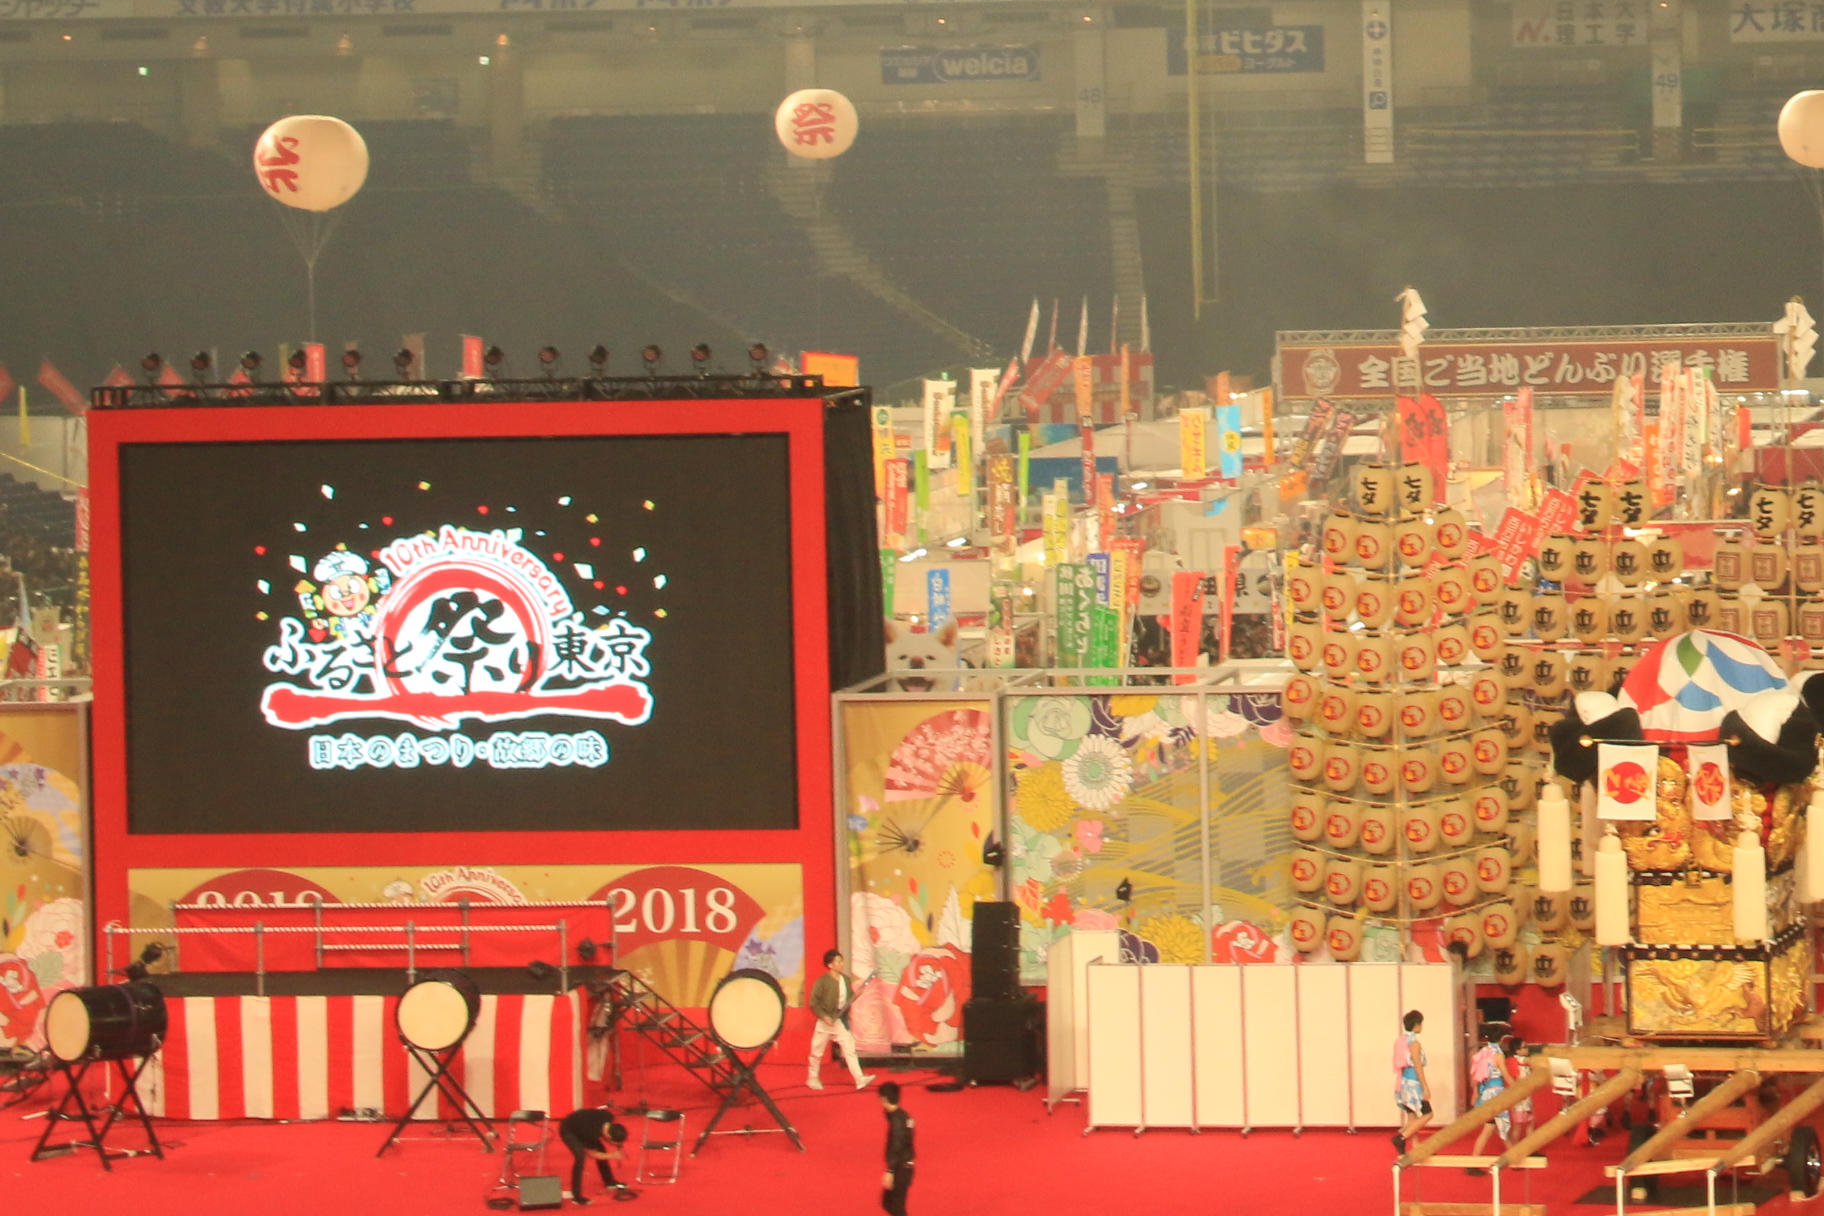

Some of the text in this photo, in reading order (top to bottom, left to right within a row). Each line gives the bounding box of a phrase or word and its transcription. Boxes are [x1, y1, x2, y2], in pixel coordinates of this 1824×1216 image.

[1221, 31, 1307, 54] ビヒダス
[942, 54, 1028, 77] welcia
[1245, 57, 1296, 70] ヨーグルト
[792, 102, 836, 146] 祭
[1757, 496, 1774, 530] 七夕
[1797, 493, 1815, 529] 七夕
[386, 528, 572, 618] 10th Anniversary
[613, 887, 737, 934] 2018
